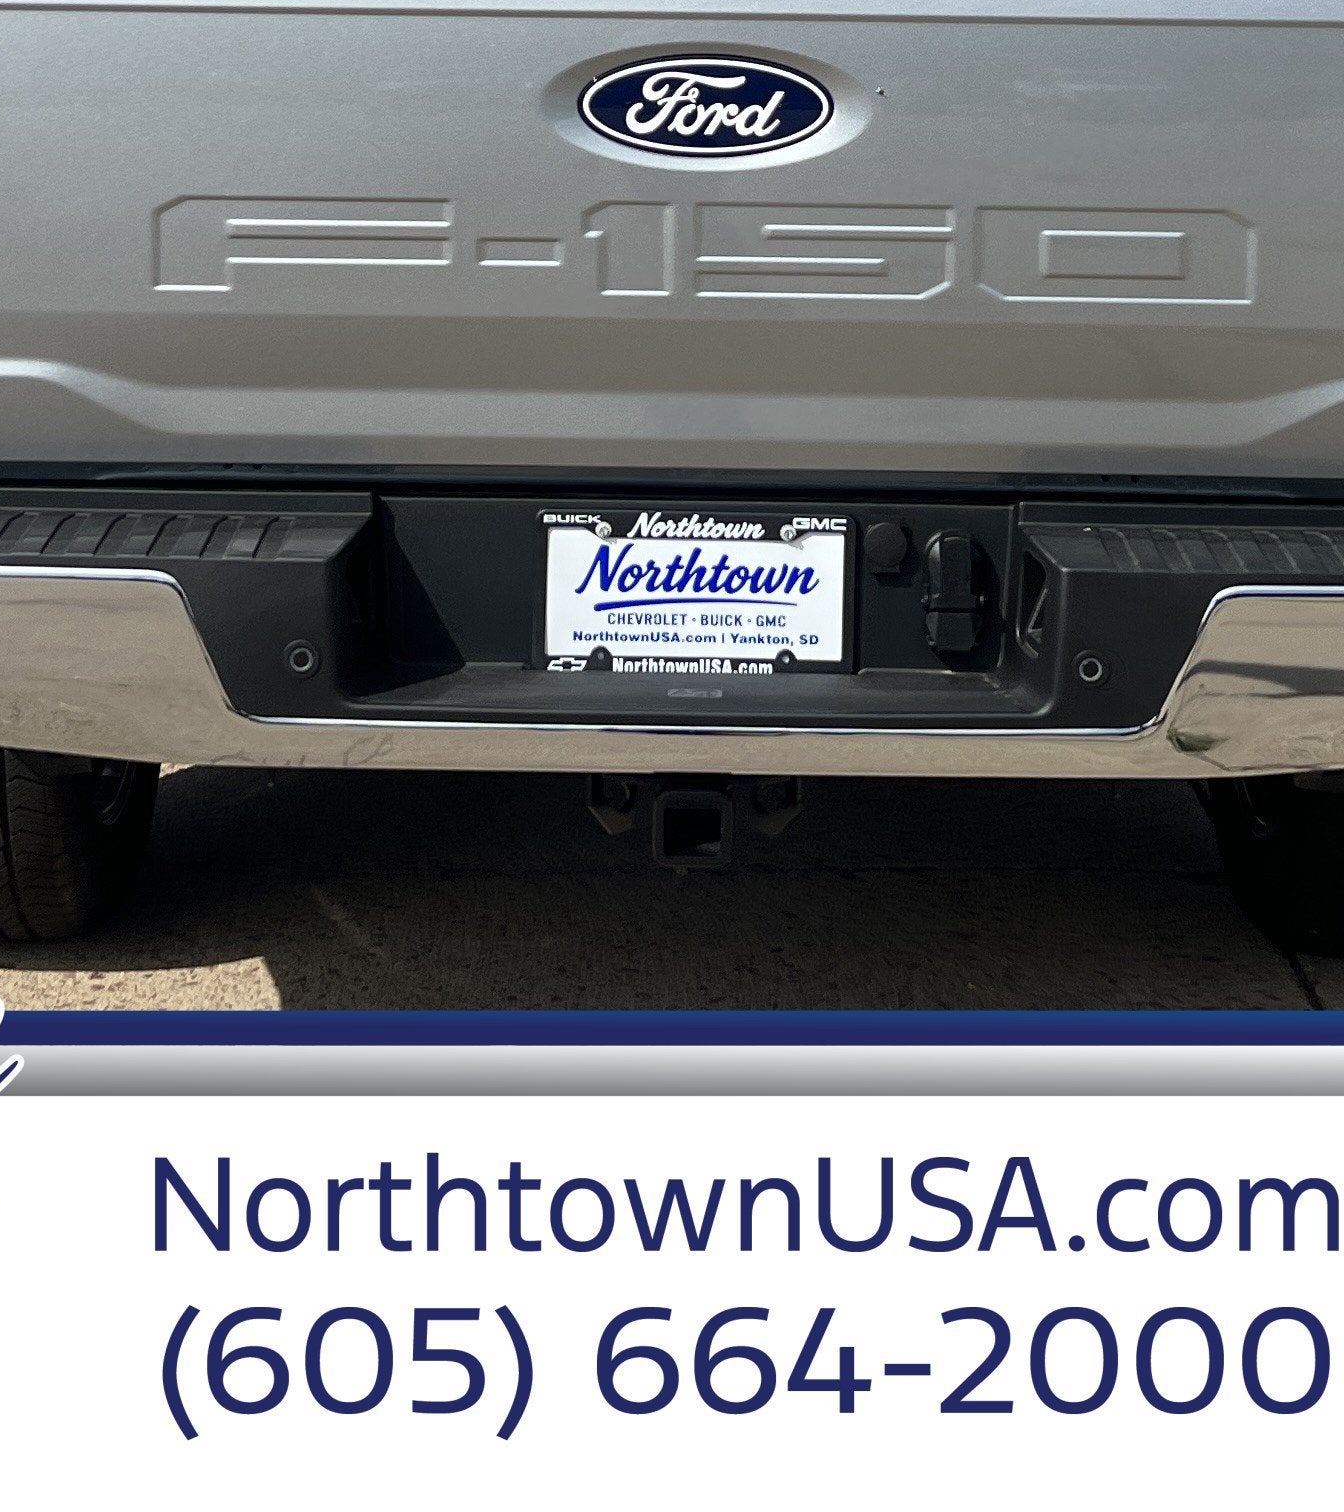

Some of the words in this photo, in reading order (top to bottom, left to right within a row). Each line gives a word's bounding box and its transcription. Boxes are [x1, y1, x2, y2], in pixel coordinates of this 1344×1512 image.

[624, 71, 784, 140] Ford
[153, 195, 1256, 304] F-150
[543, 513, 602, 524] BUICK
[627, 512, 765, 539] Northtown
[792, 517, 847, 531] GMC
[574, 543, 820, 595] Northtown
[607, 612, 688, 627] CHEVROLET
[700, 613, 743, 627] BUICK
[755, 614, 787, 627] GMC
[572, 630, 717, 644] NorthtownUSA.com
[730, 632, 794, 647] Yankton,
[799, 634, 820, 645] SD
[612, 657, 774, 675] NorthtownUSA.com
